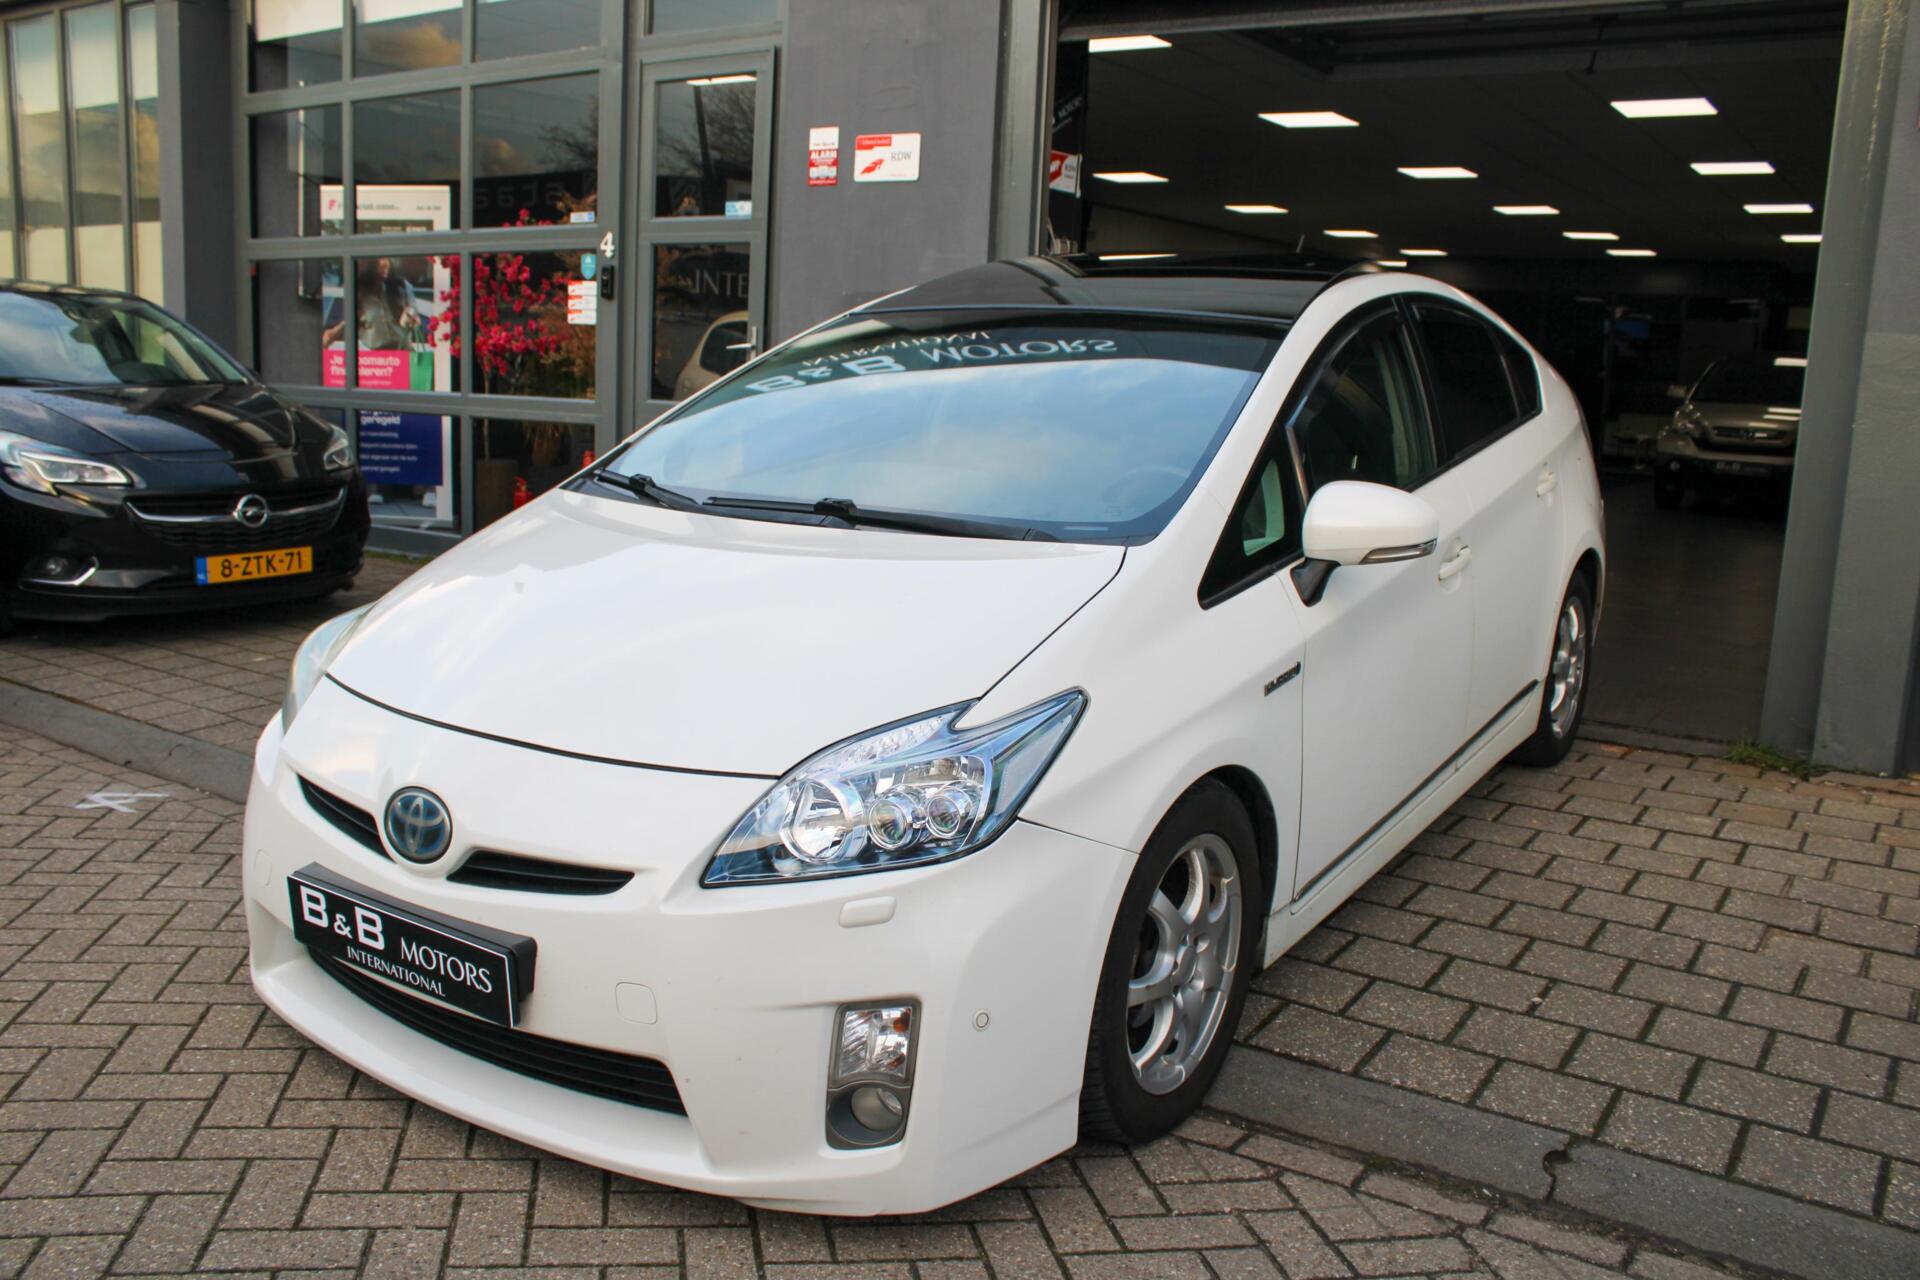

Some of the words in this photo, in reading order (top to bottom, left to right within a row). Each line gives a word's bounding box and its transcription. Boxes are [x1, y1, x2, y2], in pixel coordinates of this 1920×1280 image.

[810, 149, 838, 160] ALARM
[890, 151, 912, 161] RDW
[600, 231, 616, 259] 4
[221, 550, 302, 578] 8-ZTK-71
[346, 945, 446, 997] INTERNATIONAL
[400, 936, 493, 993] MOTORS
